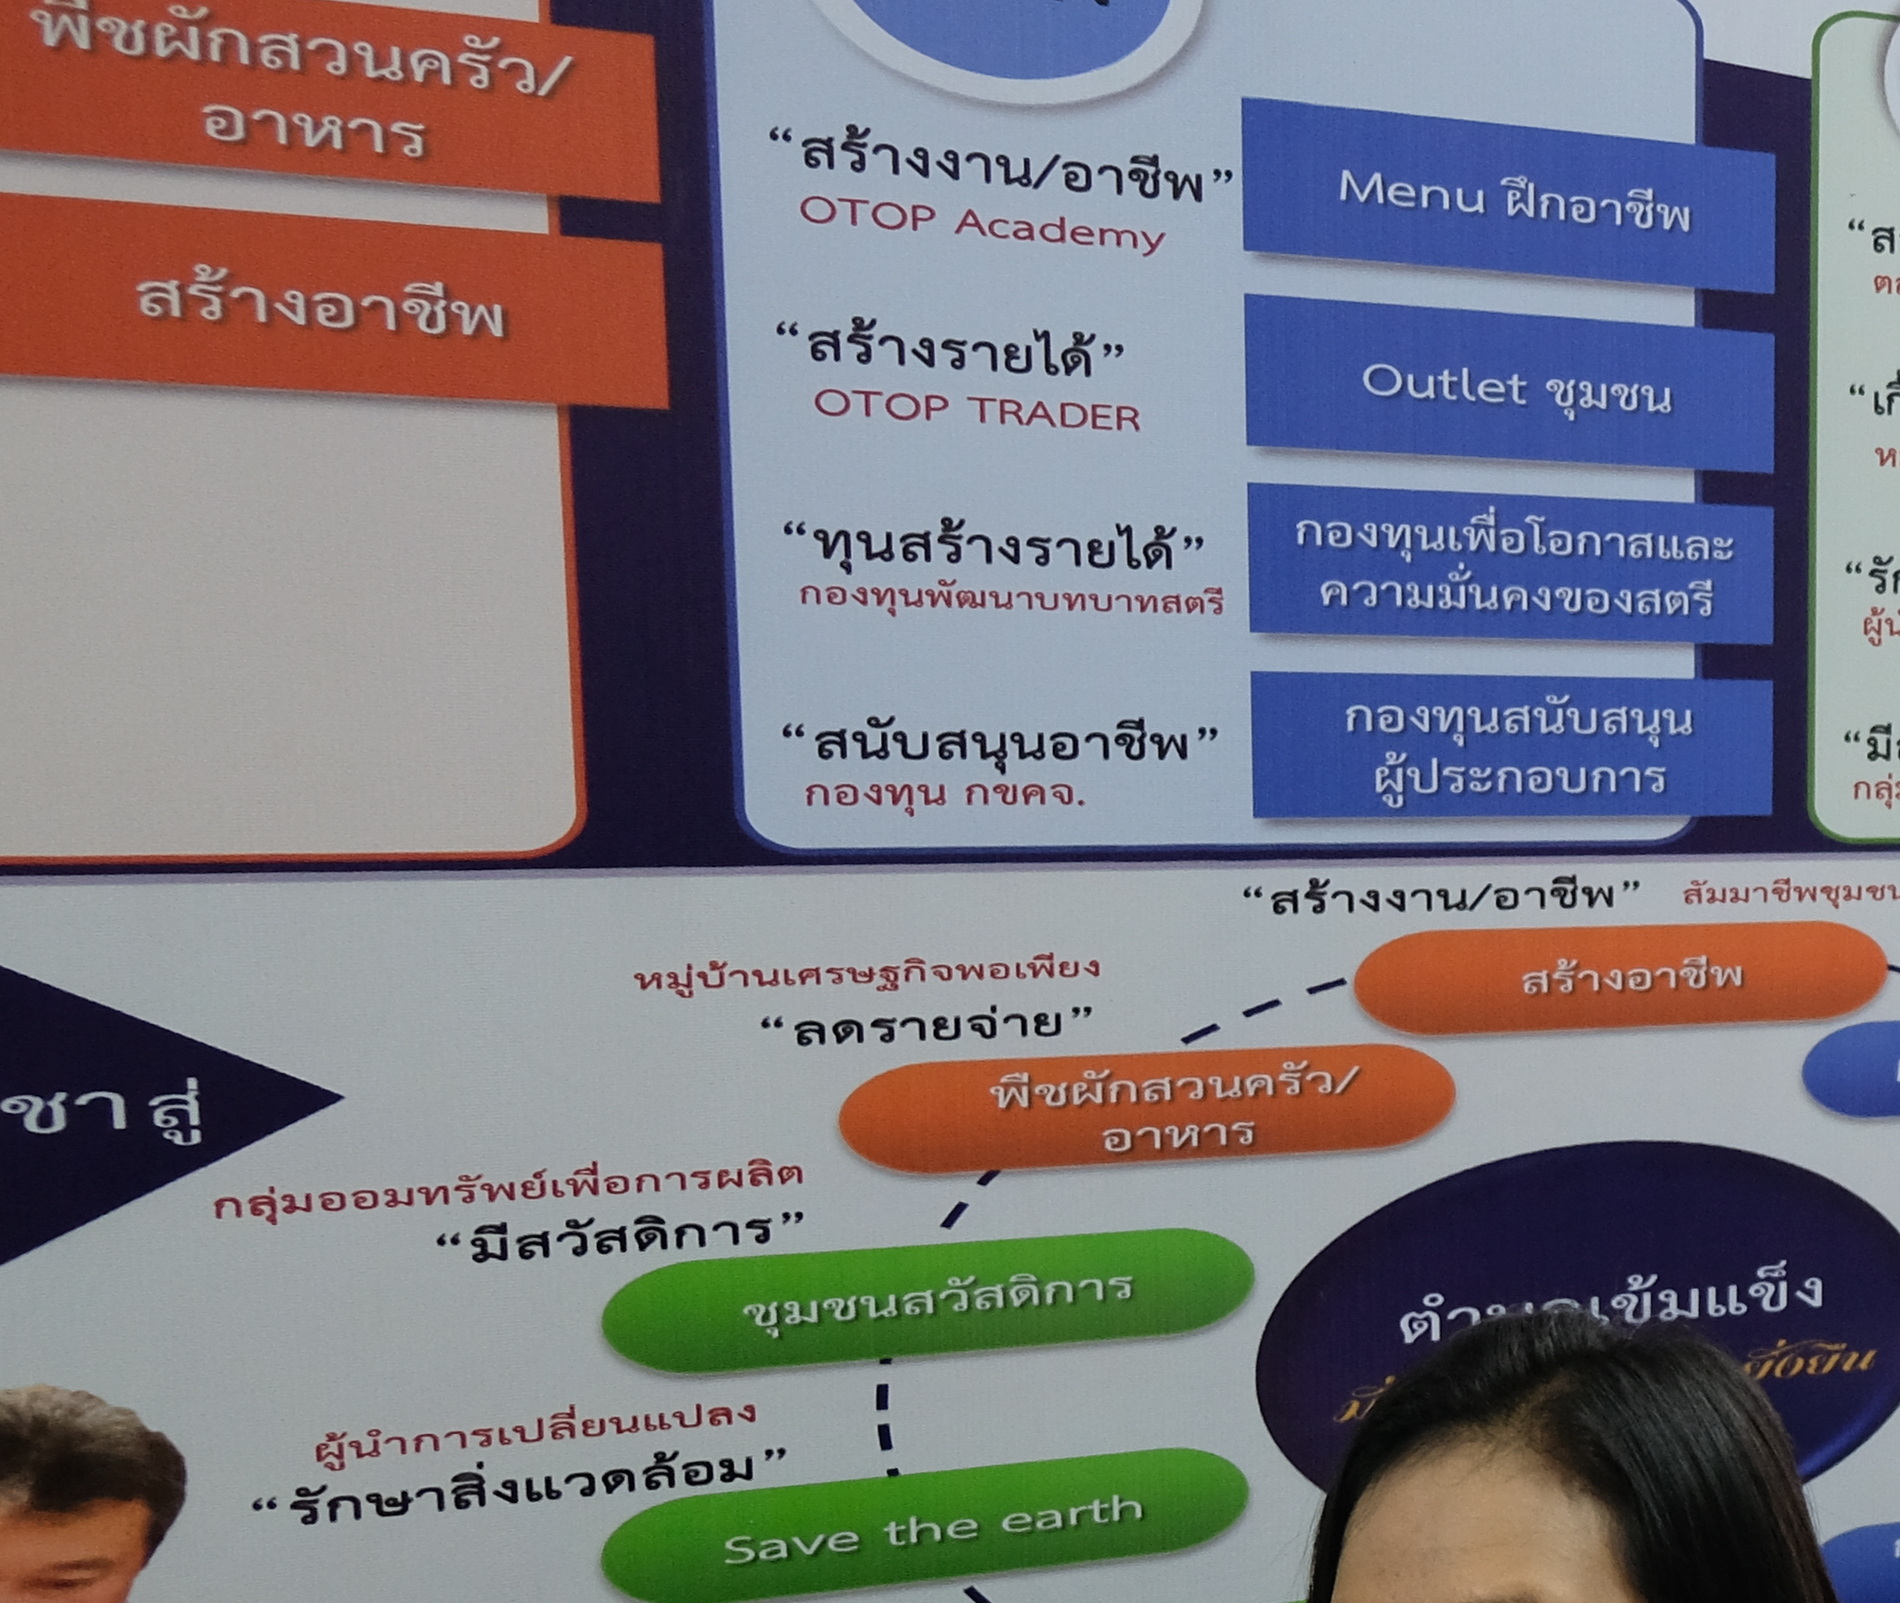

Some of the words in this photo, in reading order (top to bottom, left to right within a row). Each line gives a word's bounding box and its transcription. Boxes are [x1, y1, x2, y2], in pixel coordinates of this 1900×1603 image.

[202, 104, 426, 158] อาหาร
[798, 195, 937, 231] OTOP
[953, 209, 1167, 258] Academy
[1338, 167, 1487, 217] Menu
[1501, 174, 1693, 234] ฝึกอาชีพ
[135, 263, 507, 338] สร้างอาชีพ
[813, 388, 950, 420] OTOP
[966, 395, 1142, 432] TRADER
[1361, 361, 1528, 407] Outlet
[1545, 374, 1673, 423] ชุมชน
[1294, 507, 1734, 566] กองทุนเพื่อโอกาสและ
[799, 580, 1226, 621] กองทุนพัฒนาบทบาทสตรี
[1319, 561, 1715, 621] ความมั่นคงของสตรี
[1344, 698, 1695, 744] กองทุนสนับสนุน
[804, 776, 950, 817] กองทุน
[964, 776, 1087, 808] กขคจ.
[1373, 754, 1667, 808] ผู้ประกอบการ
[632, 953, 1102, 1000] หมู่บ้านเศรษฐกิจพอเพียง
[1520, 956, 1744, 997] สร้างอาชีพ
[148, 1077, 202, 1146] สู่
[988, 1059, 1361, 1111] พืชผักสวนครัว/
[1101, 1117, 1257, 1154] อาหาร
[212, 1159, 804, 1224] กลุ่มออมทรัพย์เพื่อการผลิต
[742, 1270, 1134, 1338] ชุมชนสวัสดิการ
[314, 1402, 758, 1469] ผู้นำการเปลี่ยนแปลง
[724, 1528, 861, 1566] Save
[883, 1514, 980, 1549] the
[1001, 1495, 1145, 1536] earth
